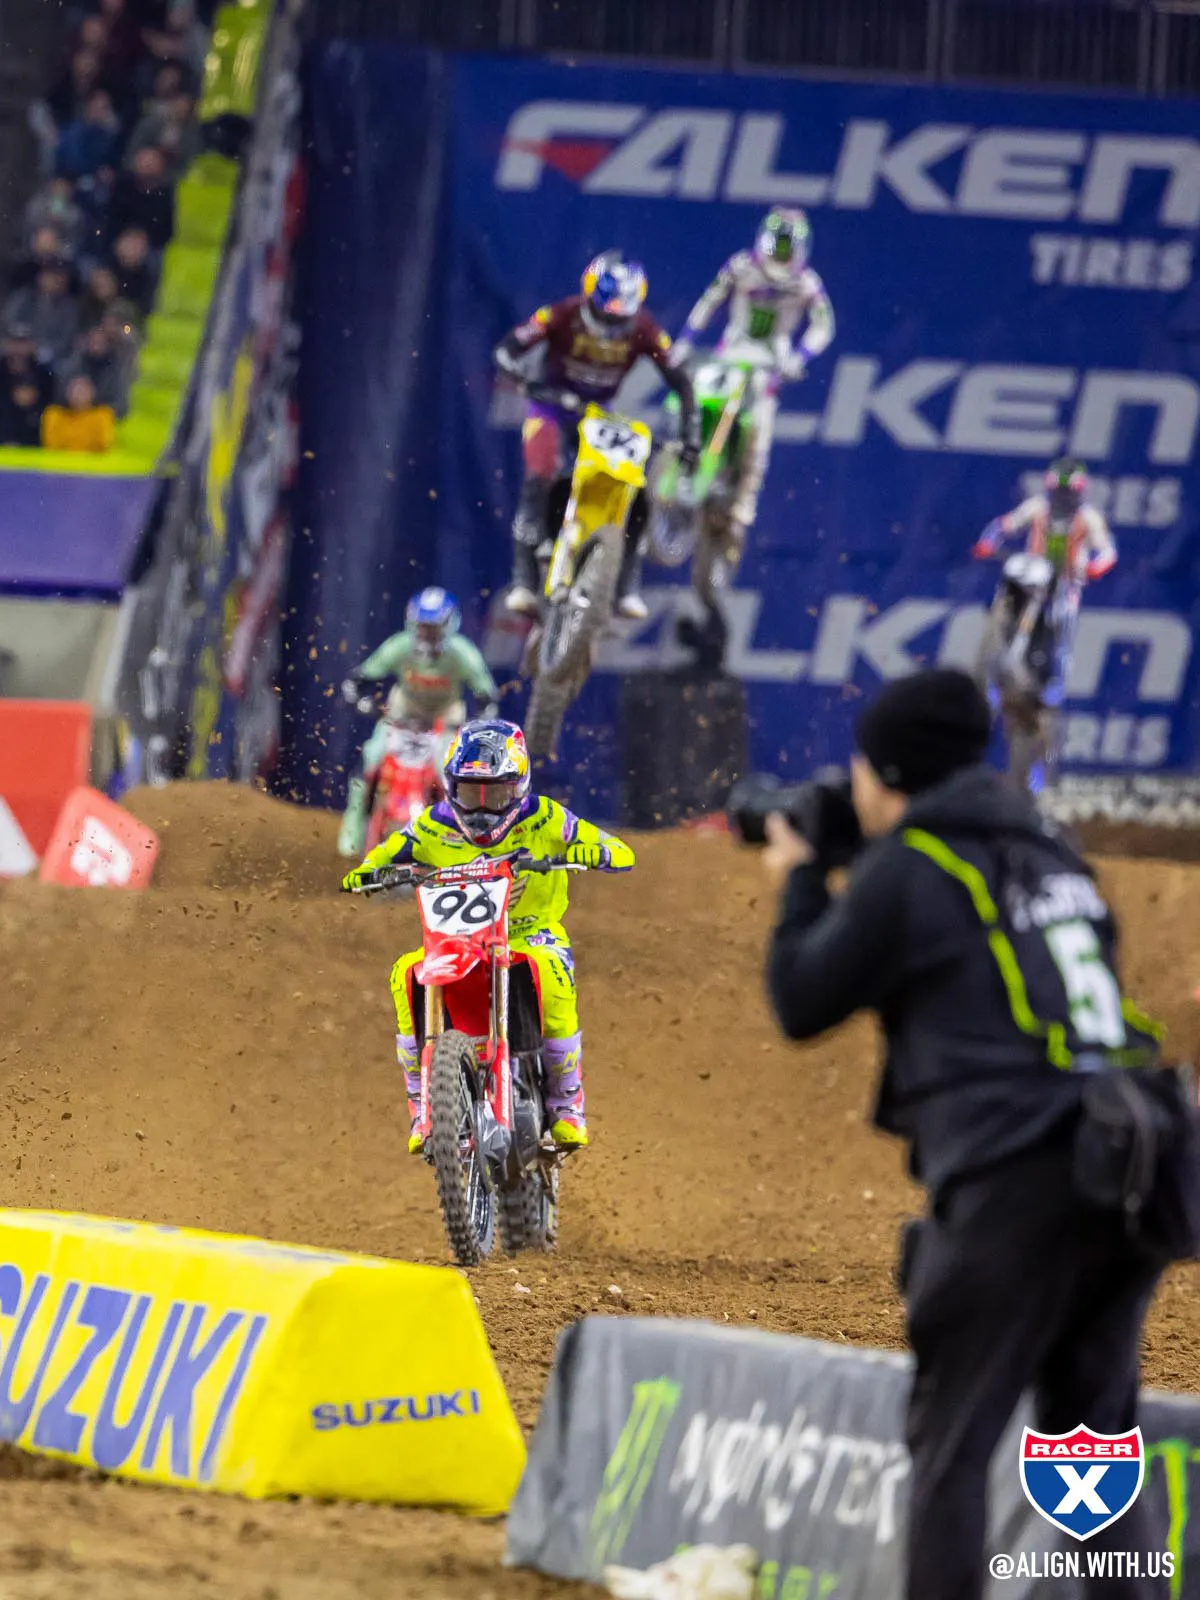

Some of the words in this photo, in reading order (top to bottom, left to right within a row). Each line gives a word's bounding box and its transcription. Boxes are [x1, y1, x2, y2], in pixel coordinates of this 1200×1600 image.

[1030, 233, 1192, 291] TIRES
[432, 890, 497, 928] 96
[311, 1388, 481, 1432] SUZUKI
